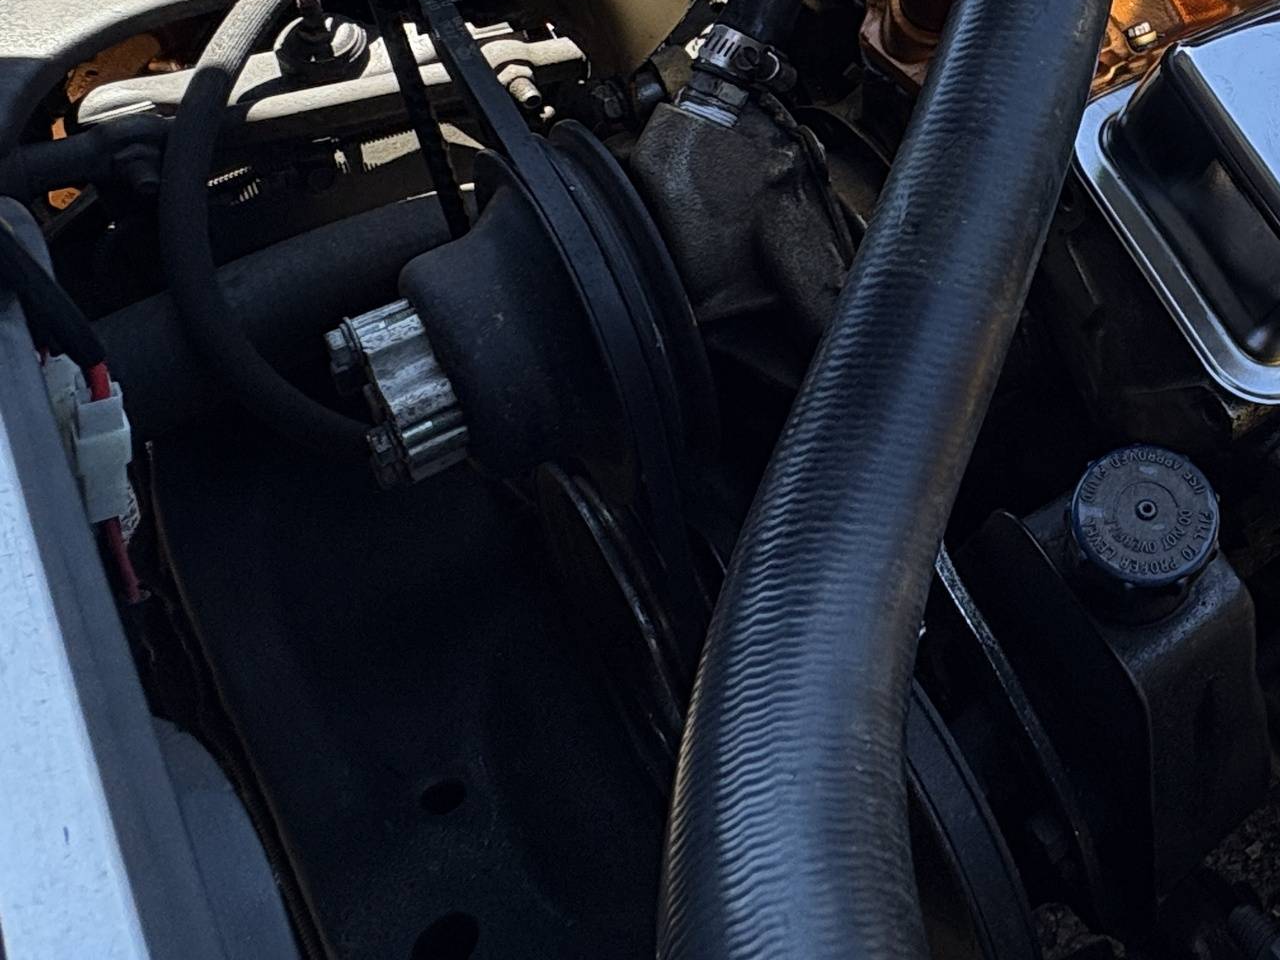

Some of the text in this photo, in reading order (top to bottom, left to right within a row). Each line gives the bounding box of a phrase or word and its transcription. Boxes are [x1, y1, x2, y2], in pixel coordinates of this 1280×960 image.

[1110, 449, 1184, 470] APPROVED
[1182, 471, 1206, 495] USE
[1178, 509, 1193, 526] DO
[1193, 512, 1211, 540] FILL
[1162, 527, 1185, 551] NOT
[1182, 543, 1198, 560] TO
[1119, 556, 1178, 574] PROPER
